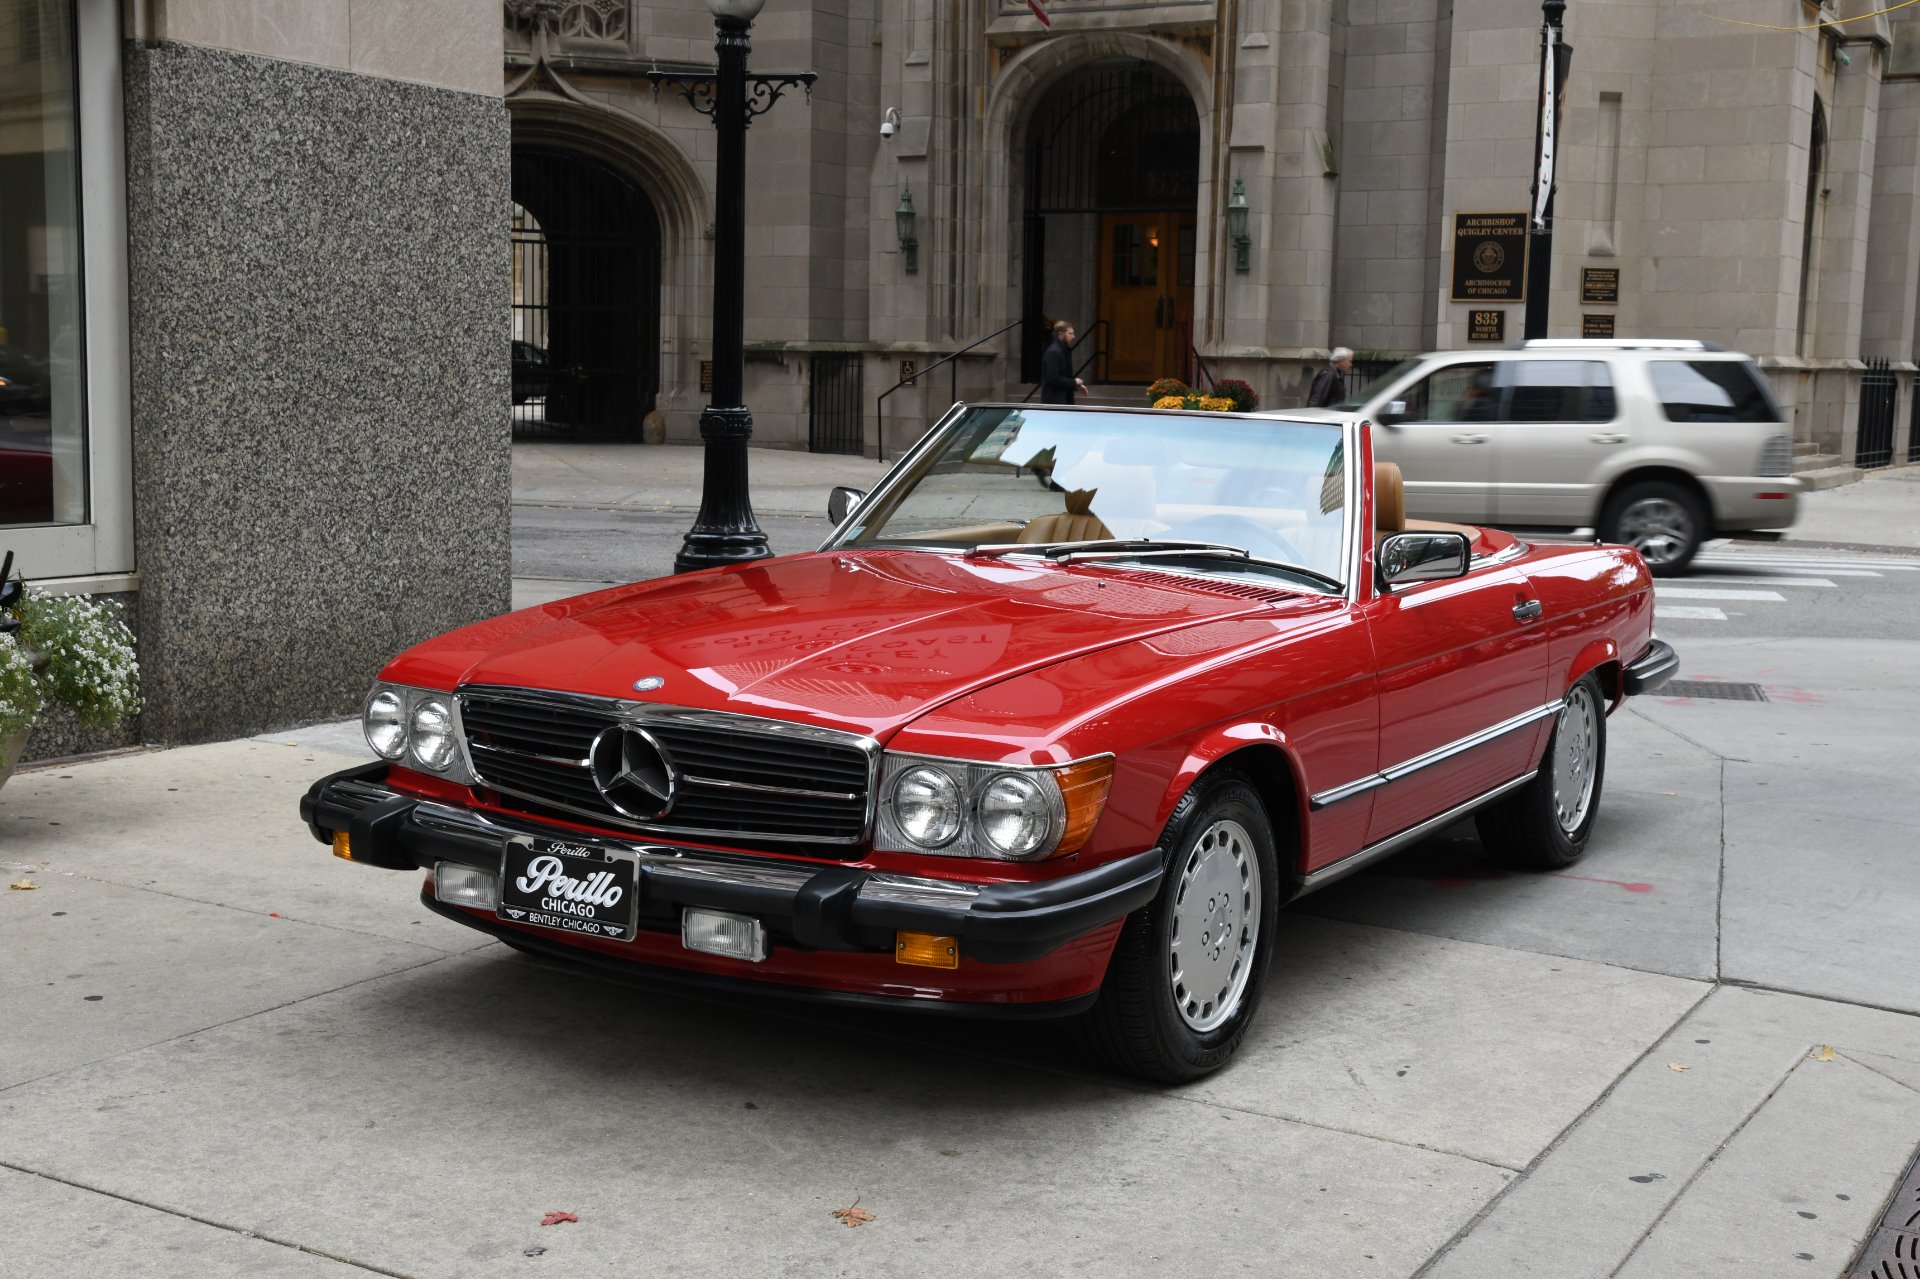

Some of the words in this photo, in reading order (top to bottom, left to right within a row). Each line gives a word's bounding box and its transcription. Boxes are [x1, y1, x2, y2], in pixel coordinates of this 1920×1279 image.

[1466, 218, 1516, 226] ARCHBISHOP
[1457, 228, 1491, 237] QUIGLEY
[1492, 228, 1524, 236] CENTER
[1464, 279, 1512, 287] ARCHDIOCESE
[1467, 287, 1476, 295] OF
[1477, 287, 1508, 295] CHICAGO
[1475, 312, 1498, 325] 835
[547, 842, 591, 858] Perillo
[515, 855, 623, 908] Perillo
[541, 897, 595, 918] CHICAGO
[529, 912, 561, 927] BENTLEY
[562, 918, 600, 933] CHICAGO
